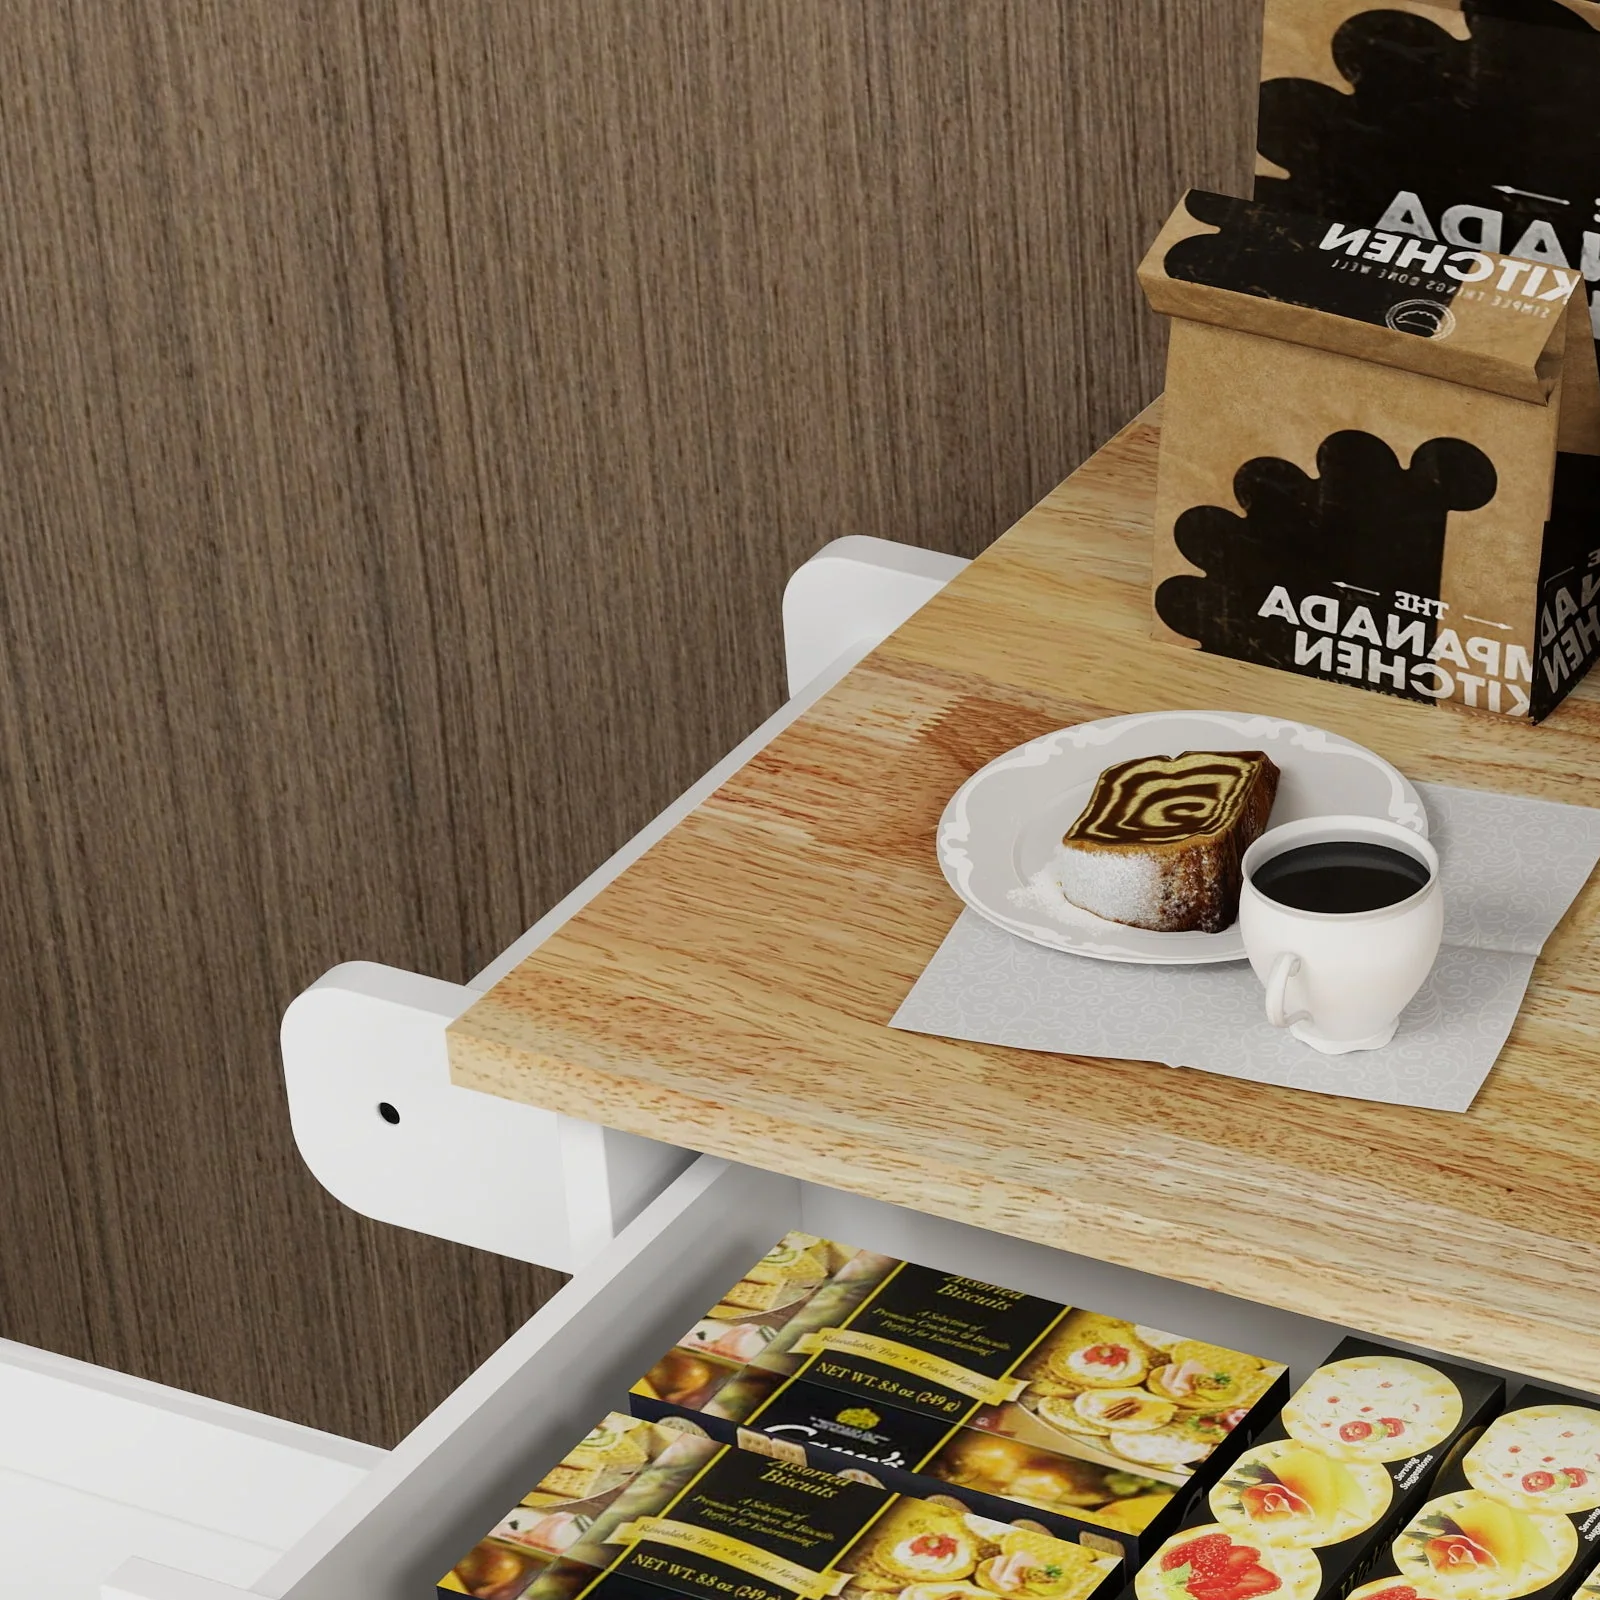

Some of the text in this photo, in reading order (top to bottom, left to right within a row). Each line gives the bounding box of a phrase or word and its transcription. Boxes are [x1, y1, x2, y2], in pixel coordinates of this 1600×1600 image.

[937, 1285, 1013, 1311] Biscuits
[815, 1361, 852, 1380] NET
[852, 1370, 877, 1387] WT.
[878, 1380, 899, 1393] 8.8
[899, 1388, 914, 1398] oz
[916, 1391, 946, 1411] (249
[760, 1471, 839, 1500] Biscuits
[1394, 1457, 1421, 1482] Serving
[1400, 1454, 1434, 1490] Suggestions
[631, 1553, 669, 1572] NET
[668, 1562, 694, 1582] WT.
[696, 1573, 717, 1587] 8.8
[717, 1581, 734, 1592] oz
